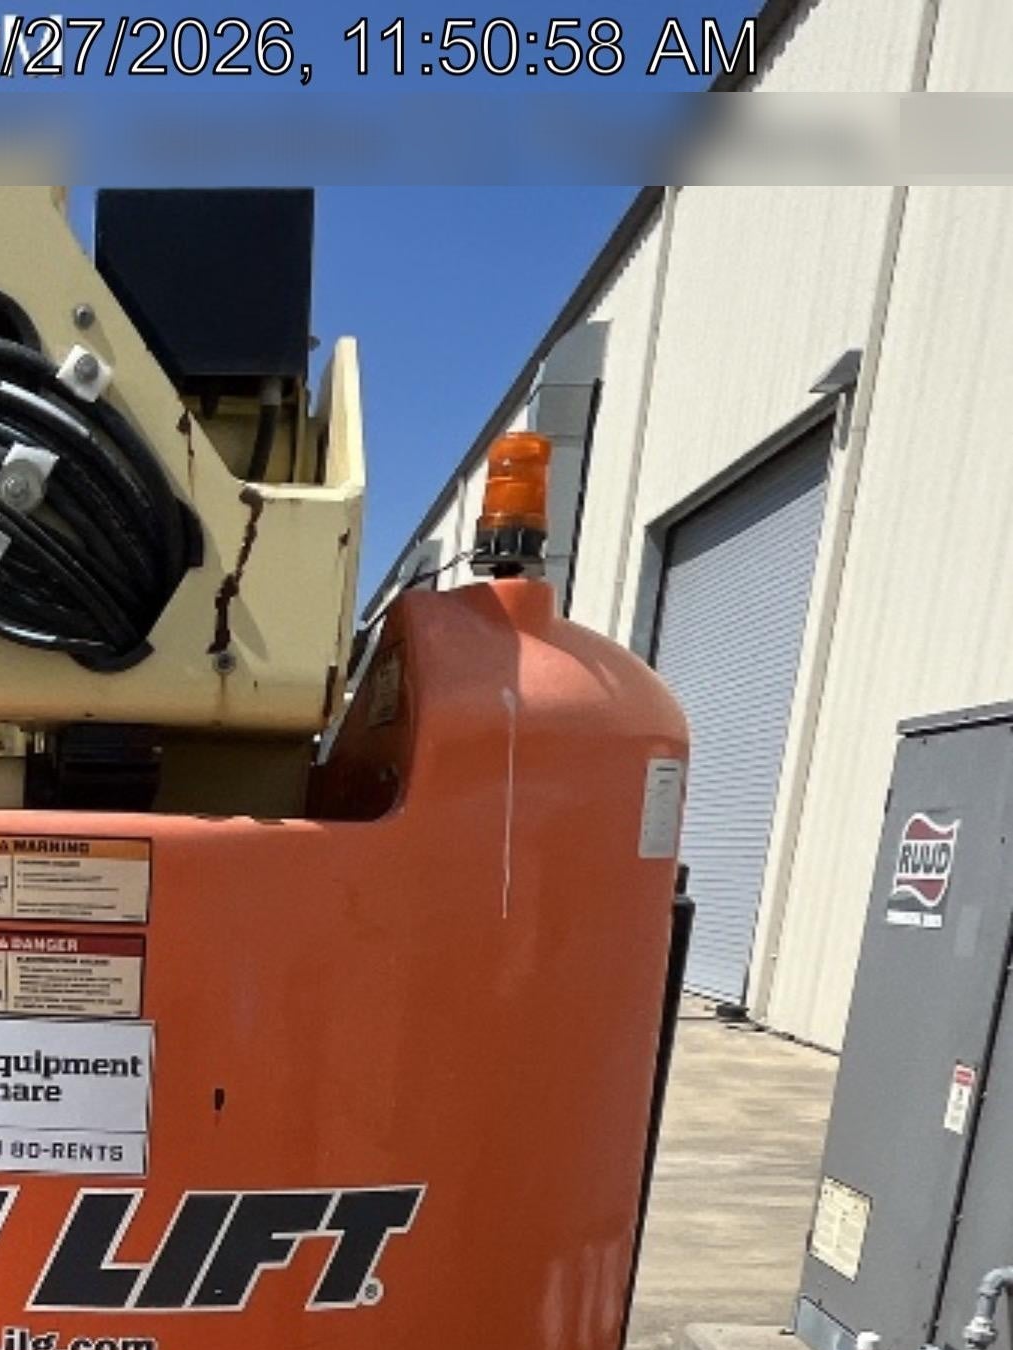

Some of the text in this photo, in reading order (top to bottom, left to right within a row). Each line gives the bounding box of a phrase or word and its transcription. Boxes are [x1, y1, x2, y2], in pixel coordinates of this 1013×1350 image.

[13, 839, 90, 854] WARNING
[898, 842, 951, 874] RUUD
[10, 936, 79, 953] DANGER
